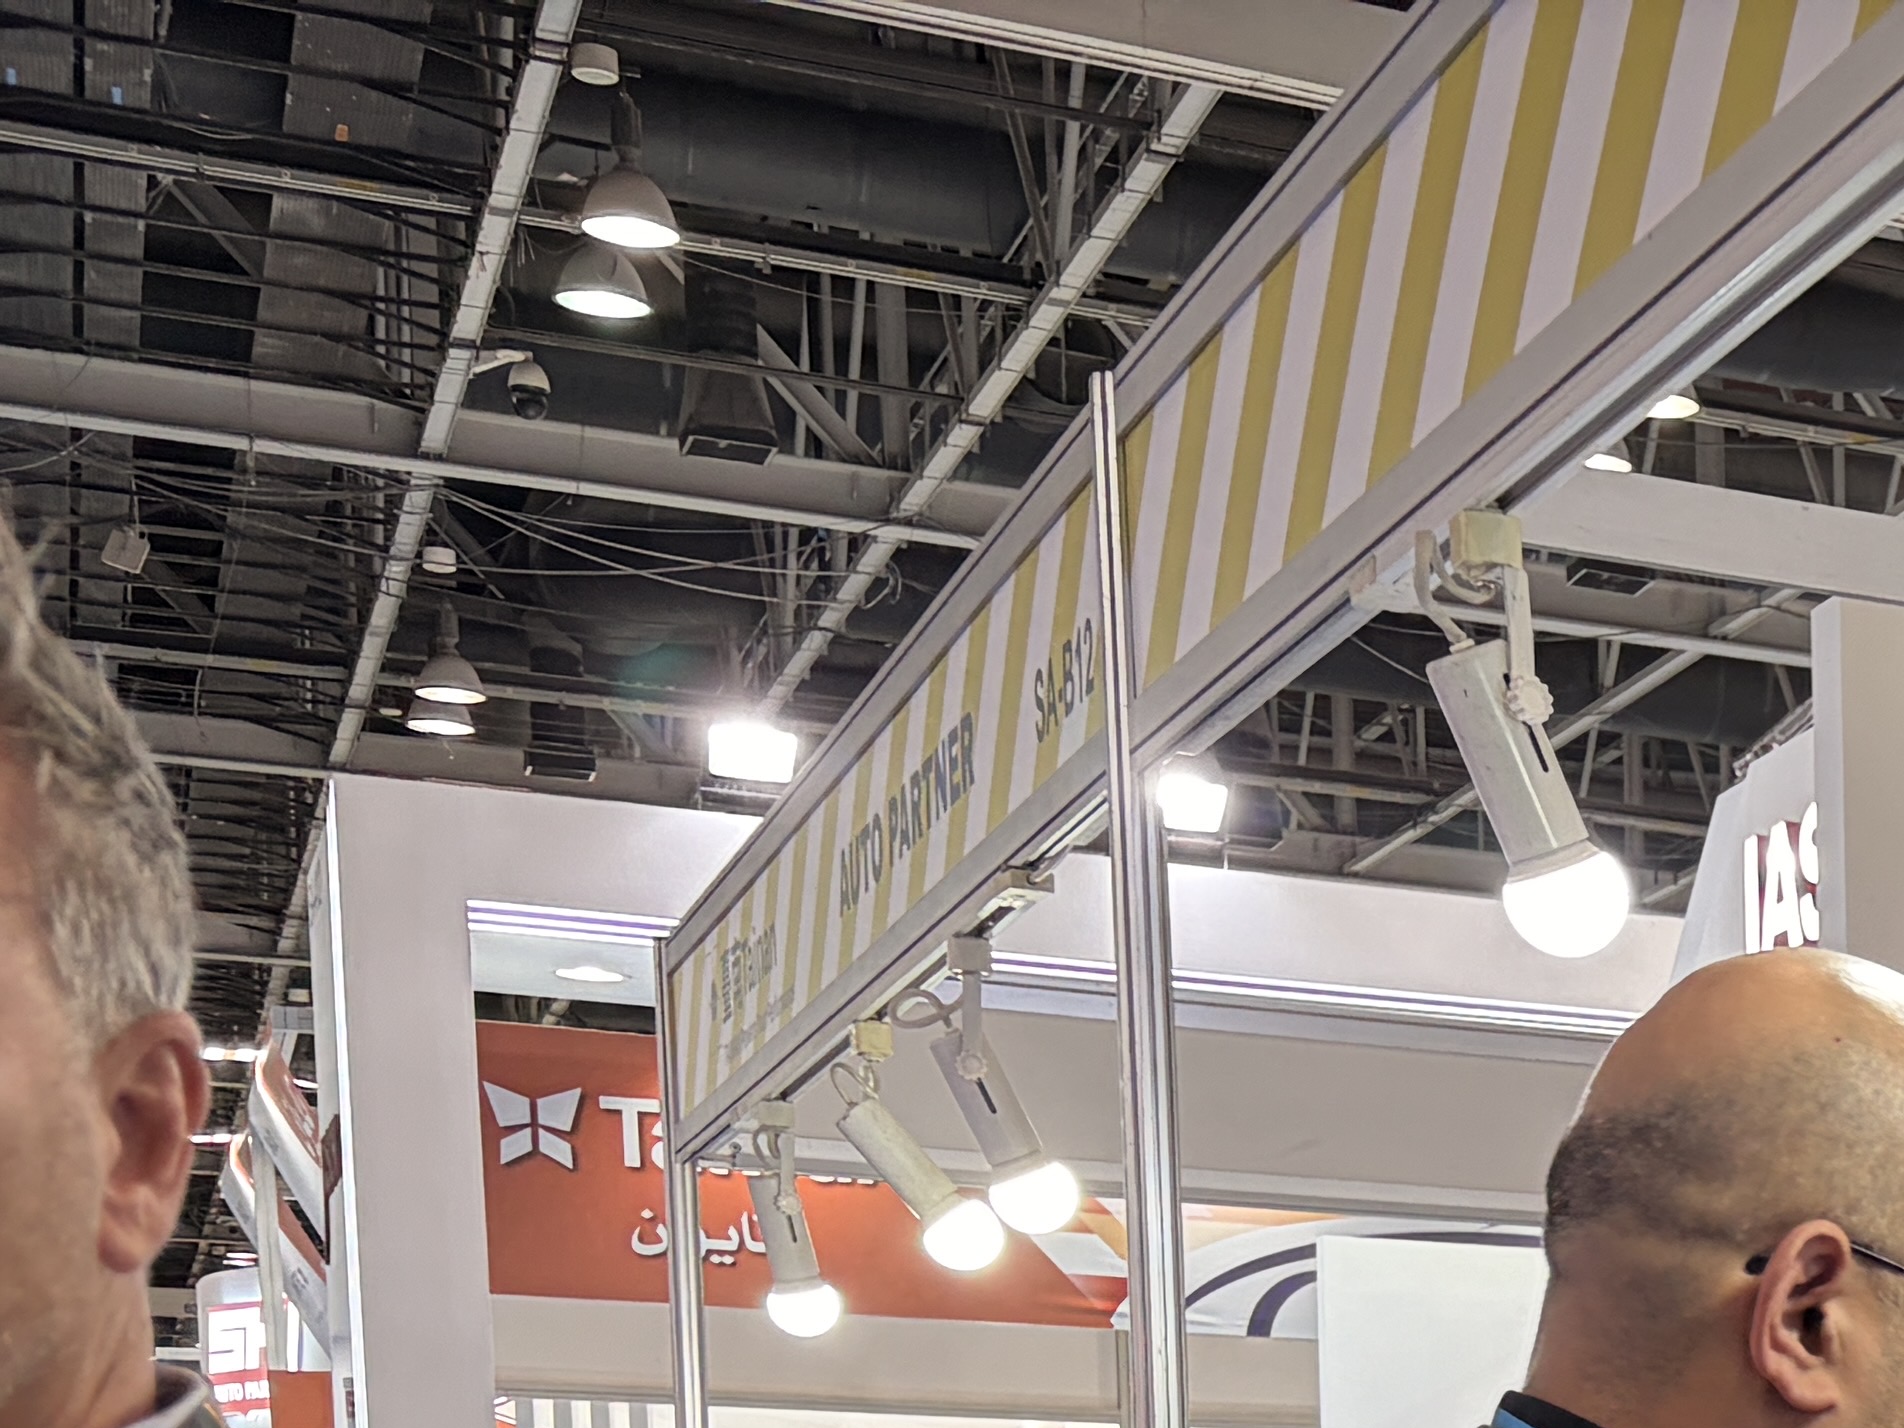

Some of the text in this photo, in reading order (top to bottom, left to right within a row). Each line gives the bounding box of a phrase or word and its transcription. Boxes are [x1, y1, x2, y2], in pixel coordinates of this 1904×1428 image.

[1035, 617, 1094, 743] SA-B12
[840, 711, 975, 918] AUTO PARTNER
